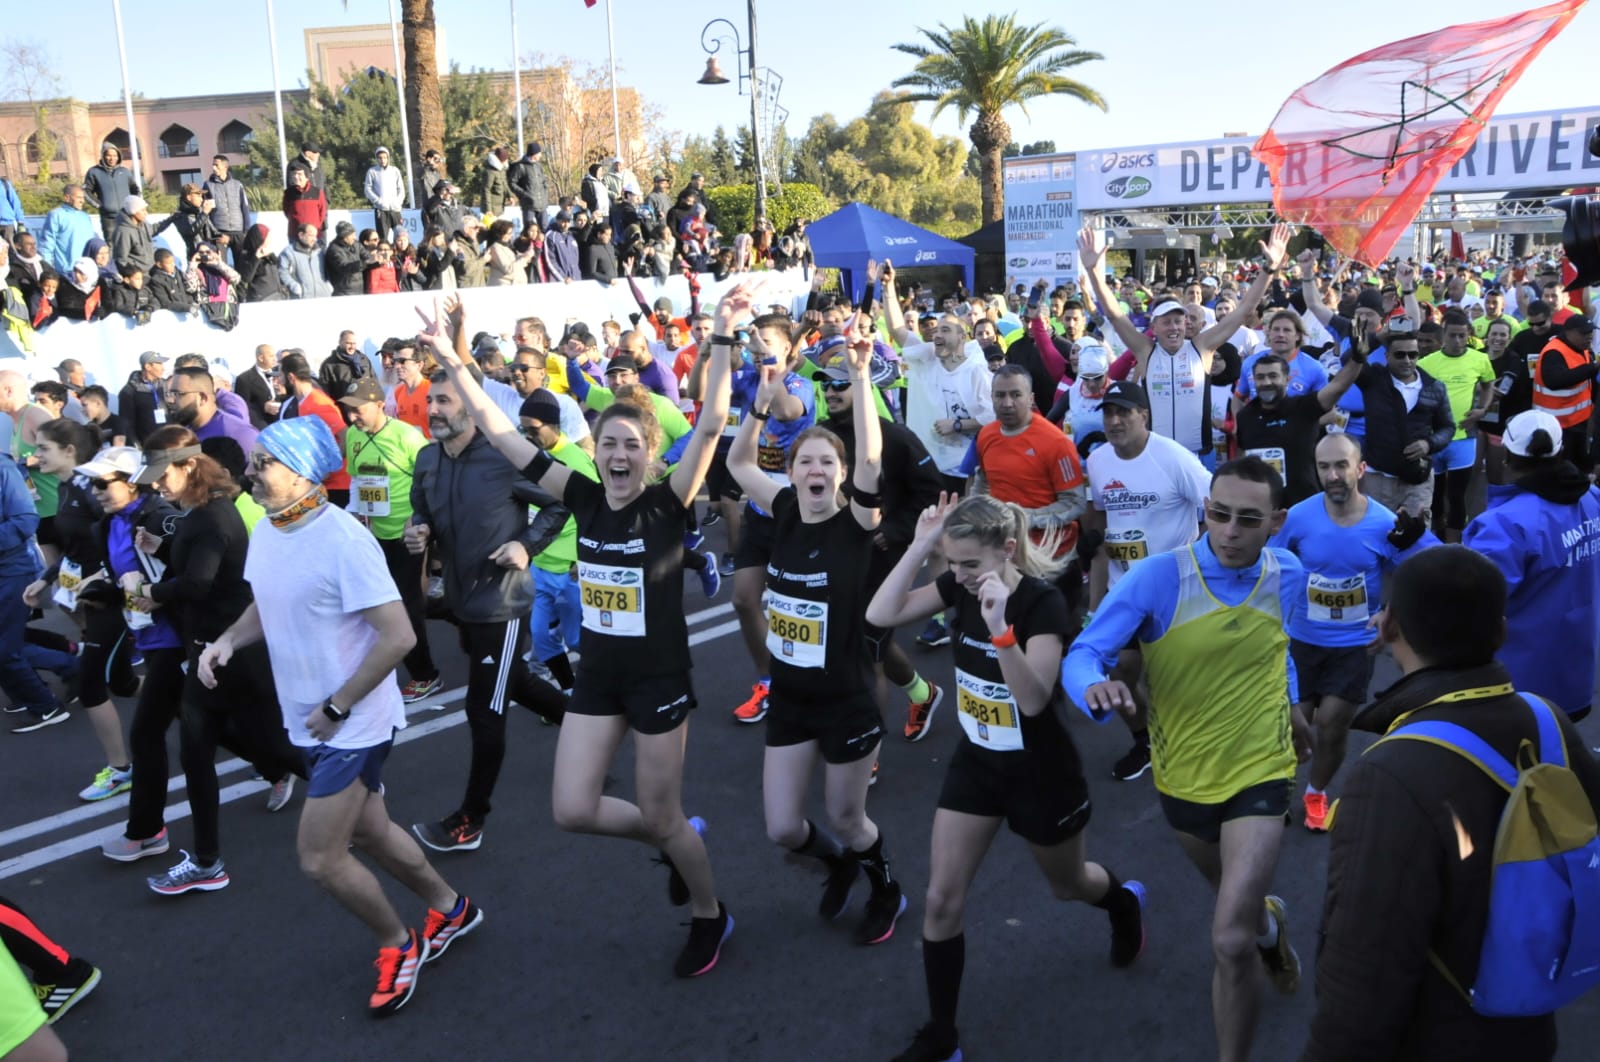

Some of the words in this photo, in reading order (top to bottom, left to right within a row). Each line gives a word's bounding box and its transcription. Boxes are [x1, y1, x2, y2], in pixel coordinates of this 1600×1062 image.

[1118, 152, 1155, 170] asics
[1180, 141, 1336, 193] DEPART
[1008, 202, 1073, 221] MARATHON
[1008, 219, 1064, 233] INTERNATIONAL
[584, 586, 628, 611] 3678
[1314, 592, 1354, 608] 4661
[771, 615, 810, 642] 3680
[963, 695, 1000, 725] 3681
